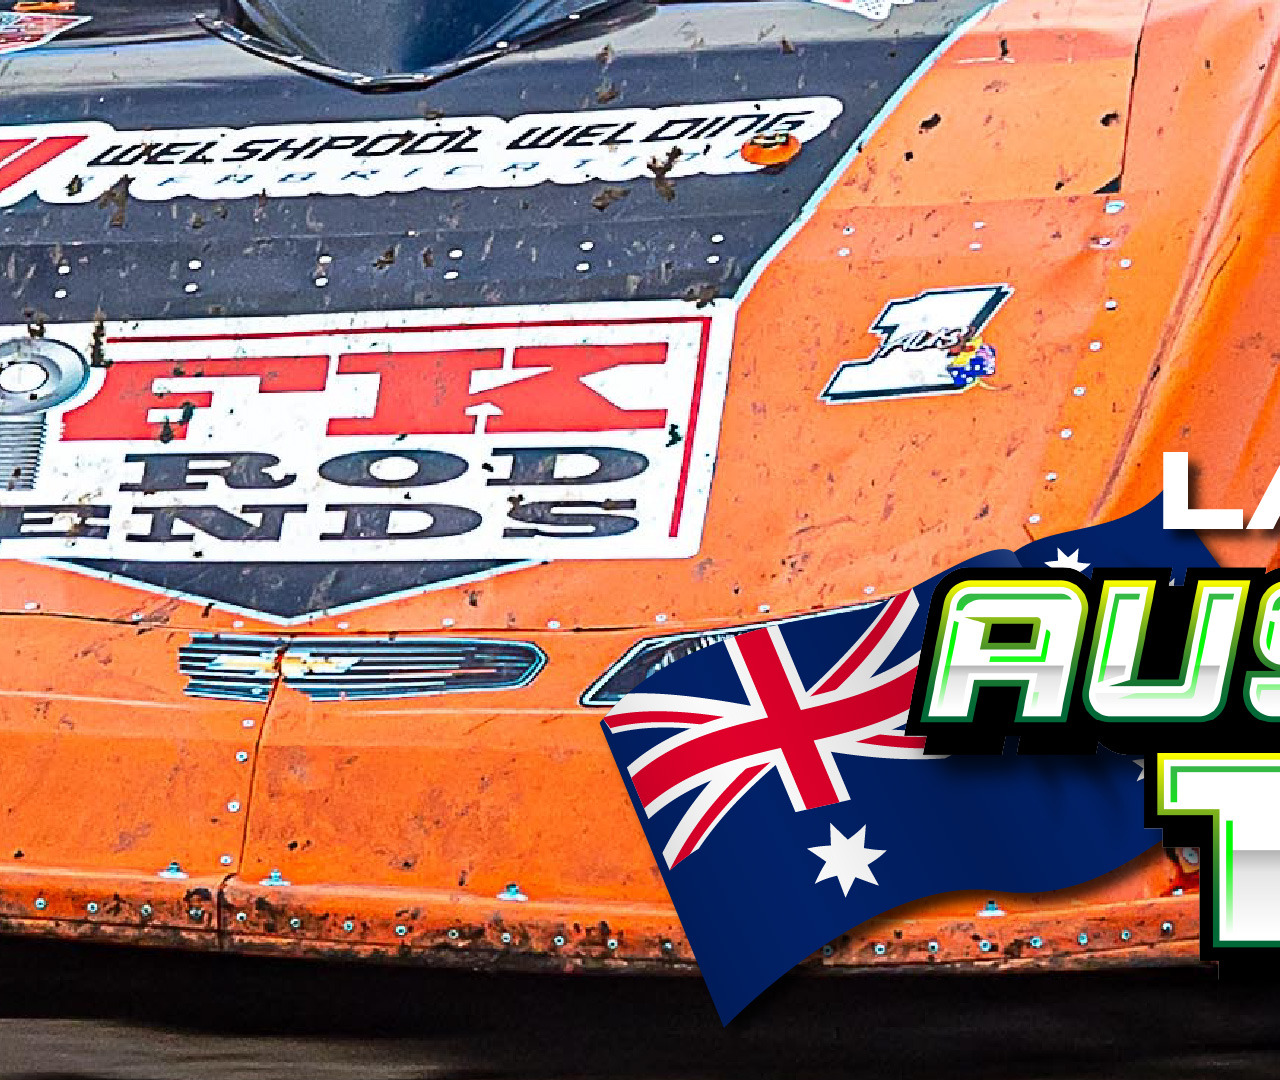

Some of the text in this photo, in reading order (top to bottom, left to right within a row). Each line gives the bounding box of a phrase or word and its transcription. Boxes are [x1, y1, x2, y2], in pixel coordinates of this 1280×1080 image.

[87, 110, 815, 166] WELSHPOOL WELDING
[59, 339, 671, 443] FK
[119, 445, 653, 493] ROD
